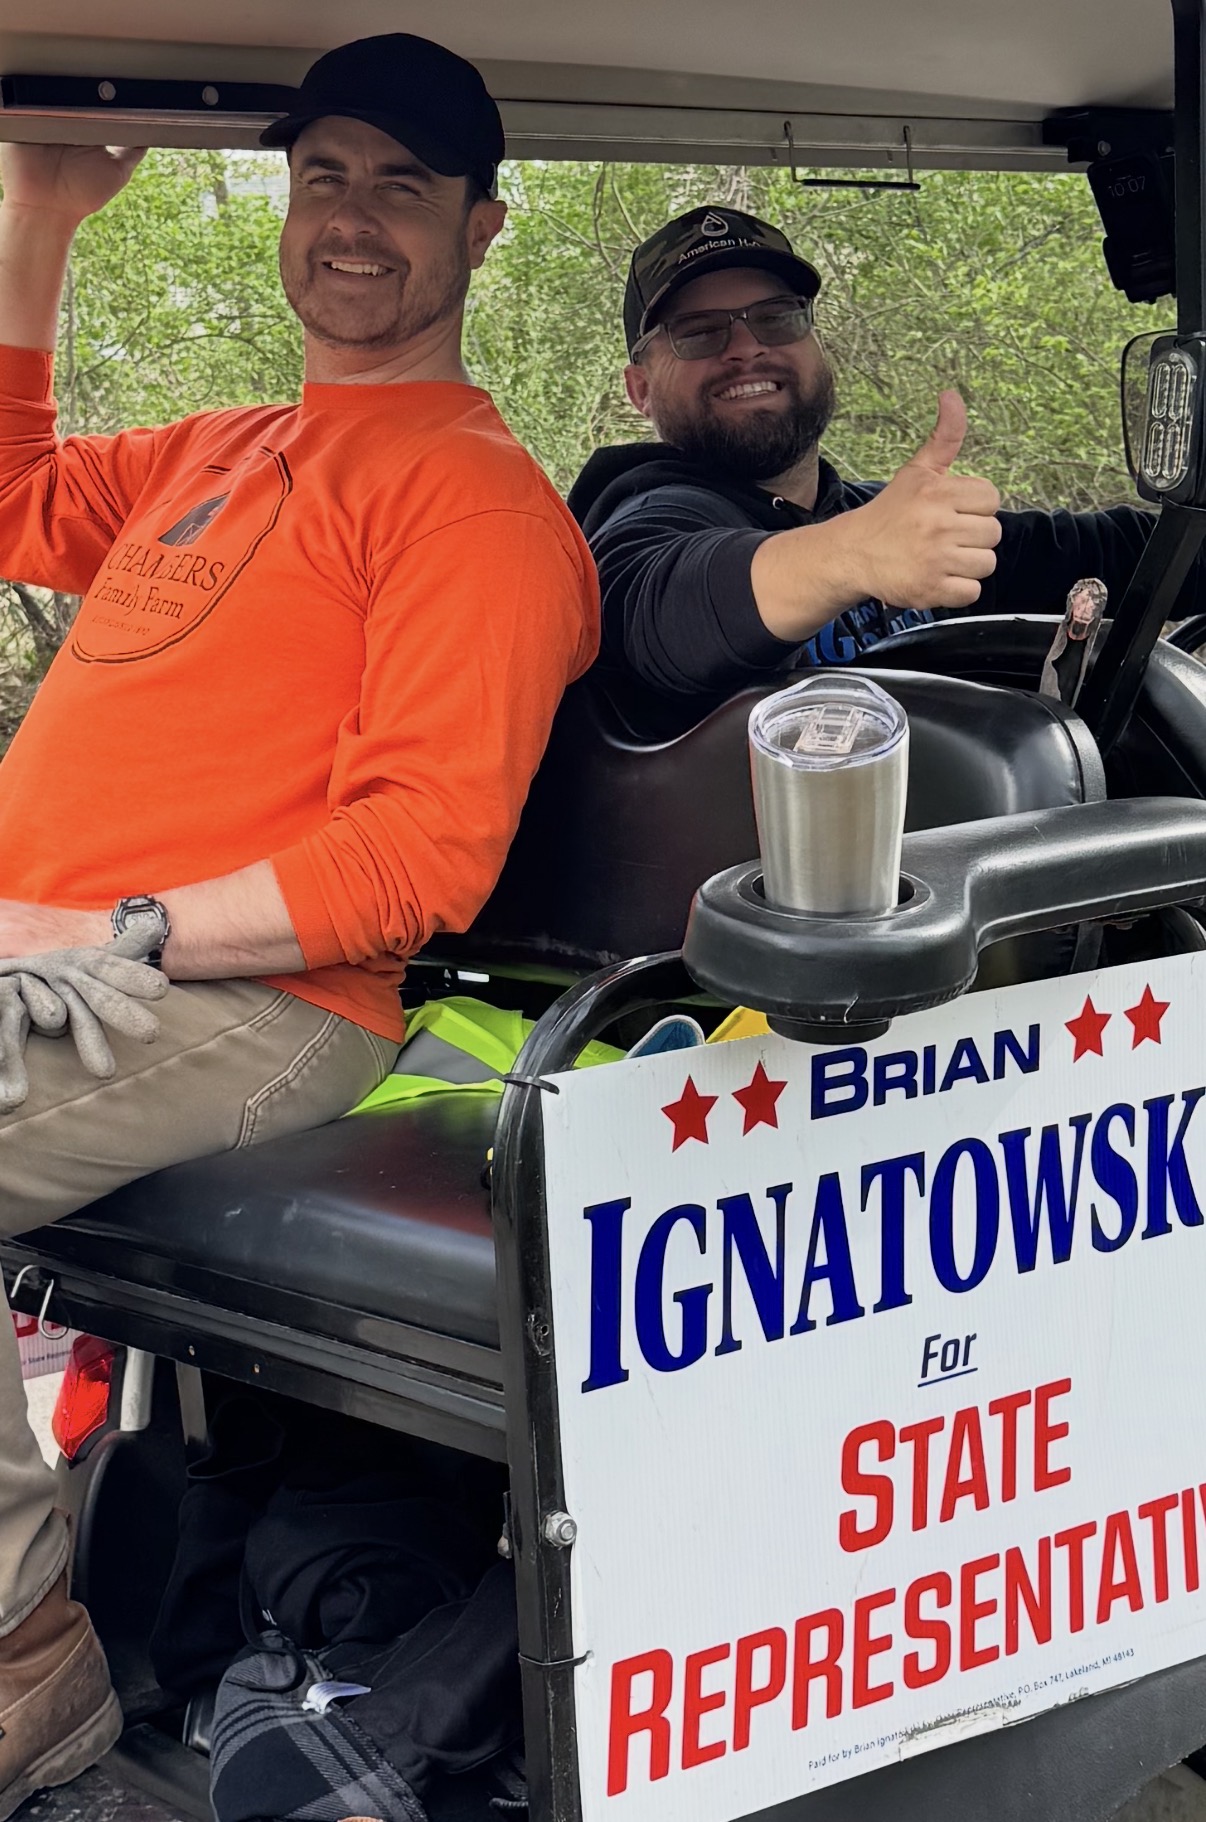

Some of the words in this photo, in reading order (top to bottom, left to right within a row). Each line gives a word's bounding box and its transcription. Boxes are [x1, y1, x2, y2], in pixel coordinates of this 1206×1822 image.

[677, 237, 736, 265] American
[141, 586, 185, 620] Farm
[810, 1023, 1041, 1121] BRIAN
[581, 1086, 1206, 1394] IGNATOWSK
[920, 1333, 977, 1379] For
[838, 1377, 1073, 1554] STATE
[606, 1483, 1206, 1797] REPRESENTATI
[808, 1756, 826, 1770] Paid
[828, 1752, 840, 1763] for
[842, 1748, 852, 1760] by
[854, 1741, 876, 1754] Brian
[1034, 1680, 1048, 1690] Box
[1065, 1662, 1101, 1680] Lakeland,
[1102, 1655, 1112, 1667] MI
